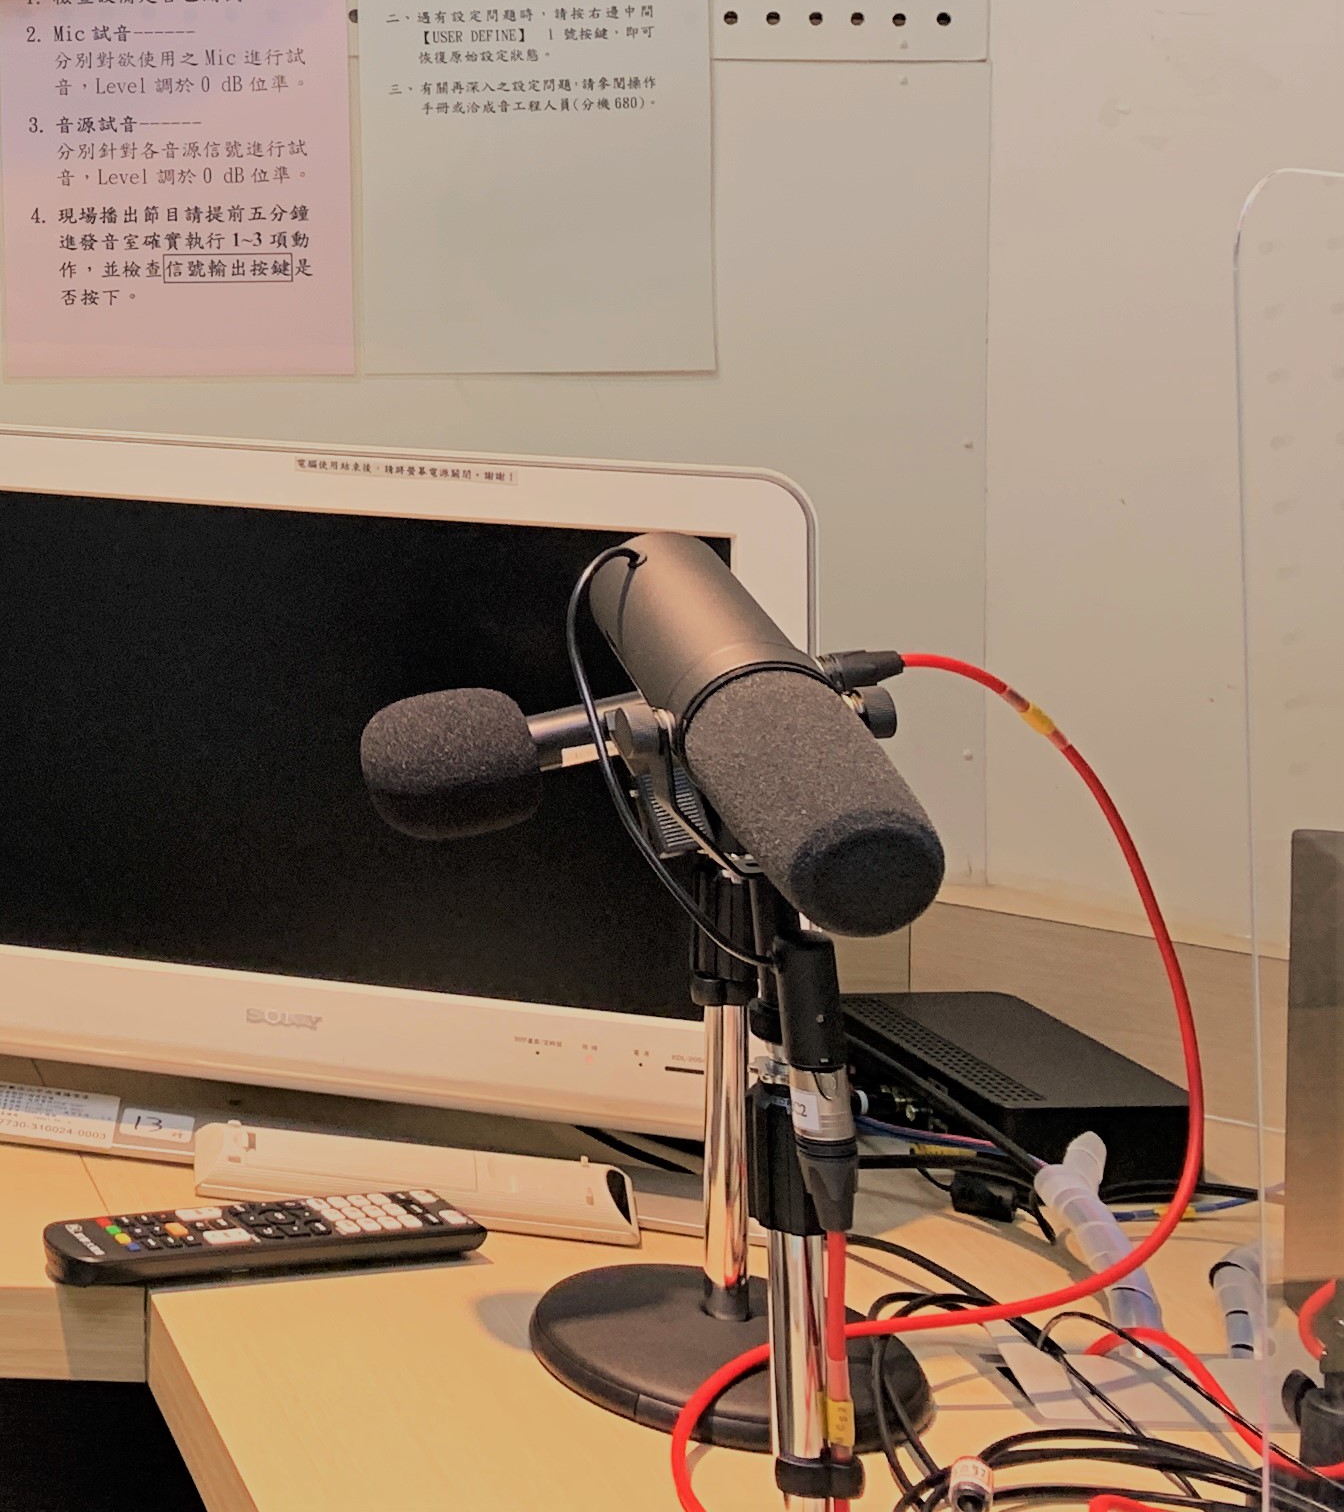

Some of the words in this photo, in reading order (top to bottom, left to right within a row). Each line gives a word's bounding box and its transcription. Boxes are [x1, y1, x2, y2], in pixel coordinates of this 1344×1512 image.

[26, 27, 41, 42] 2.
[54, 26, 85, 42] Mic
[205, 49, 236, 66] Mic
[222, 75, 243, 92] dB
[28, 117, 43, 133] 3.
[58, 139, 308, 160] 分別針對各音源信號進行試
[224, 167, 245, 183] dB
[31, 208, 46, 224] 4.
[59, 203, 310, 225] 現場播出節目請提前五分鐘
[134, 1115, 163, 1133] 13
